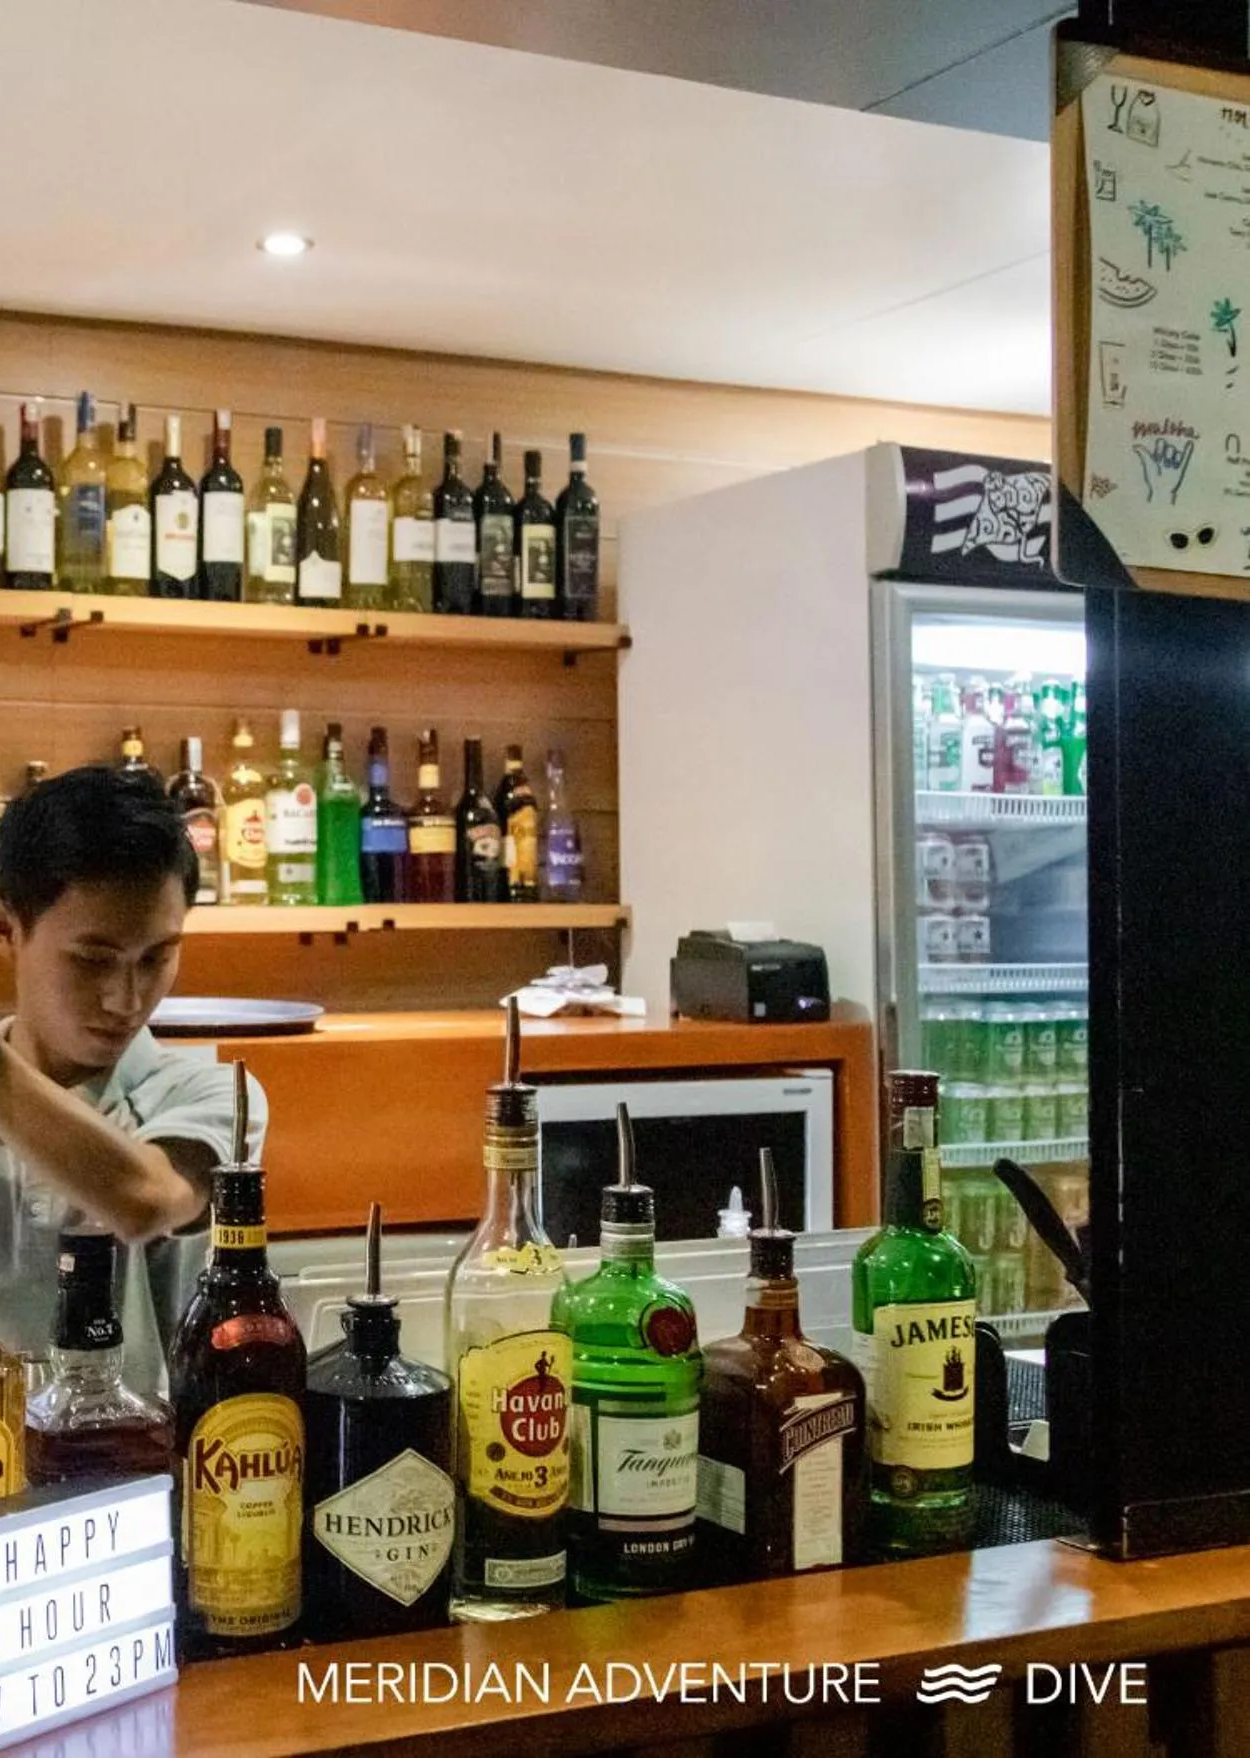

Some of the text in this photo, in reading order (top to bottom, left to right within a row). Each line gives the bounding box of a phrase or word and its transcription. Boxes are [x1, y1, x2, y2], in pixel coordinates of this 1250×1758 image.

[511, 1416, 560, 1442] Club
[195, 1438, 302, 1495] KAHLÚA
[533, 1465, 548, 1488] 3
[4, 1510, 120, 1583] HAPPY
[386, 1544, 430, 1562] GIN
[19, 1583, 112, 1650] HOUR
[27, 1665, 67, 1717] TO
